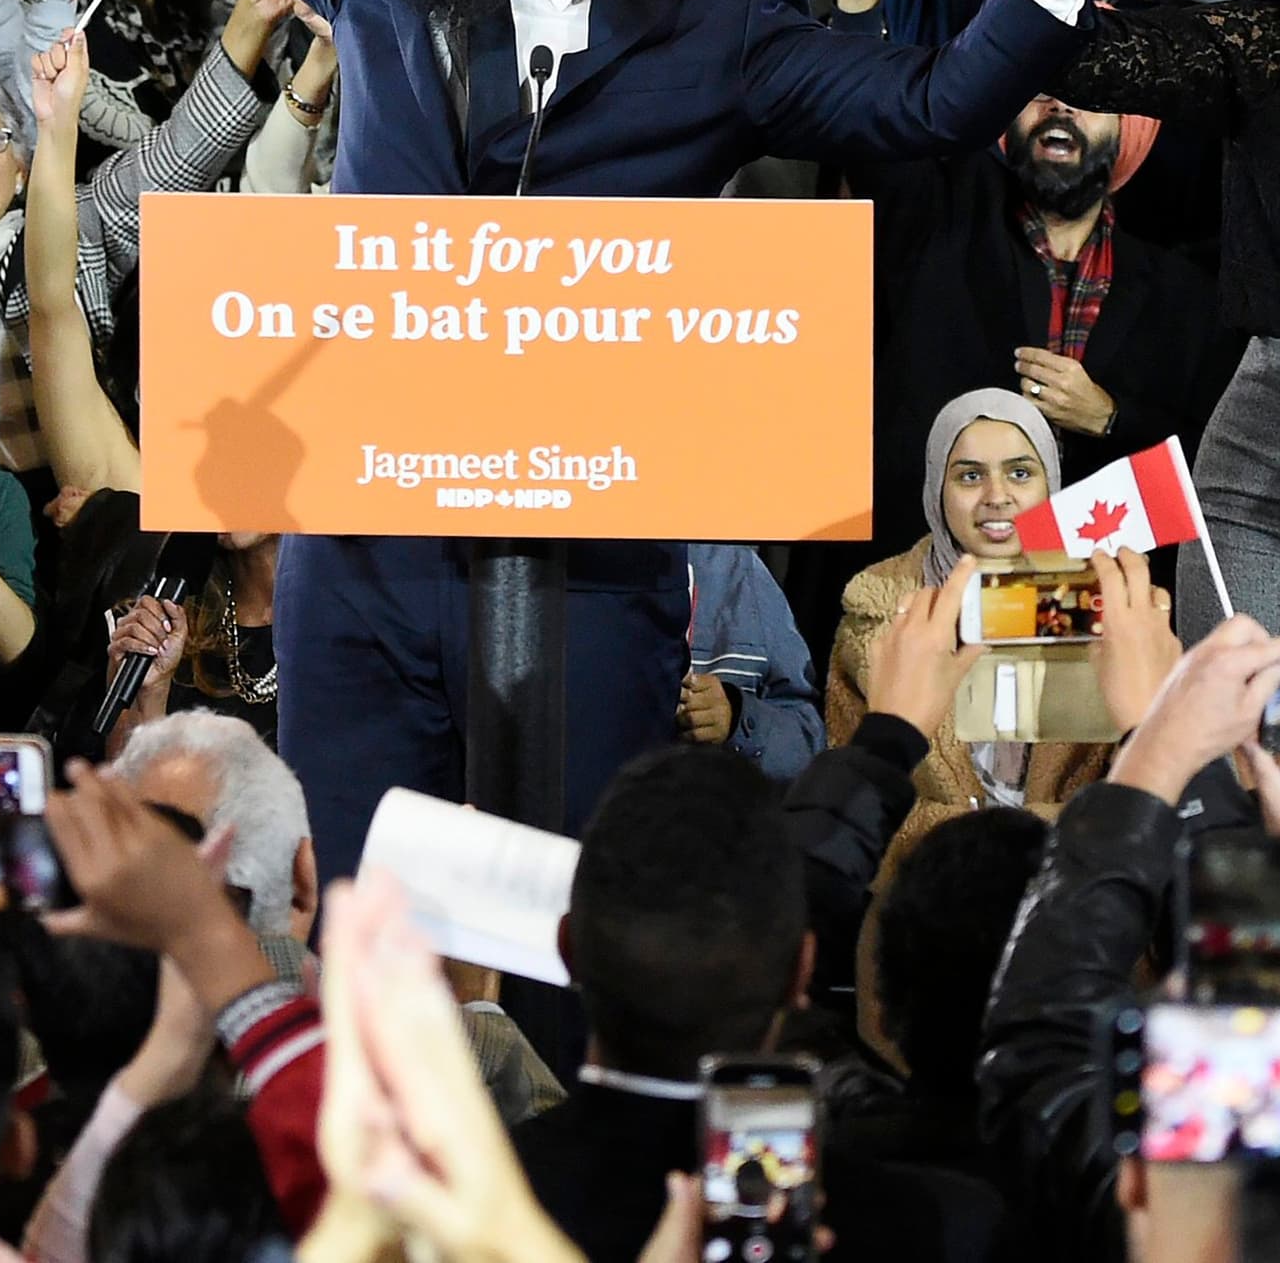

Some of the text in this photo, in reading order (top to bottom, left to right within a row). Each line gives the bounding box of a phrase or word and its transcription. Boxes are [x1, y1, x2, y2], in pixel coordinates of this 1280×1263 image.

[334, 221, 673, 287] In it for you
[211, 290, 800, 355] On se bat pour vous
[357, 445, 638, 490] Jagmeet Singh
[436, 488, 572, 509] NDP NPD
